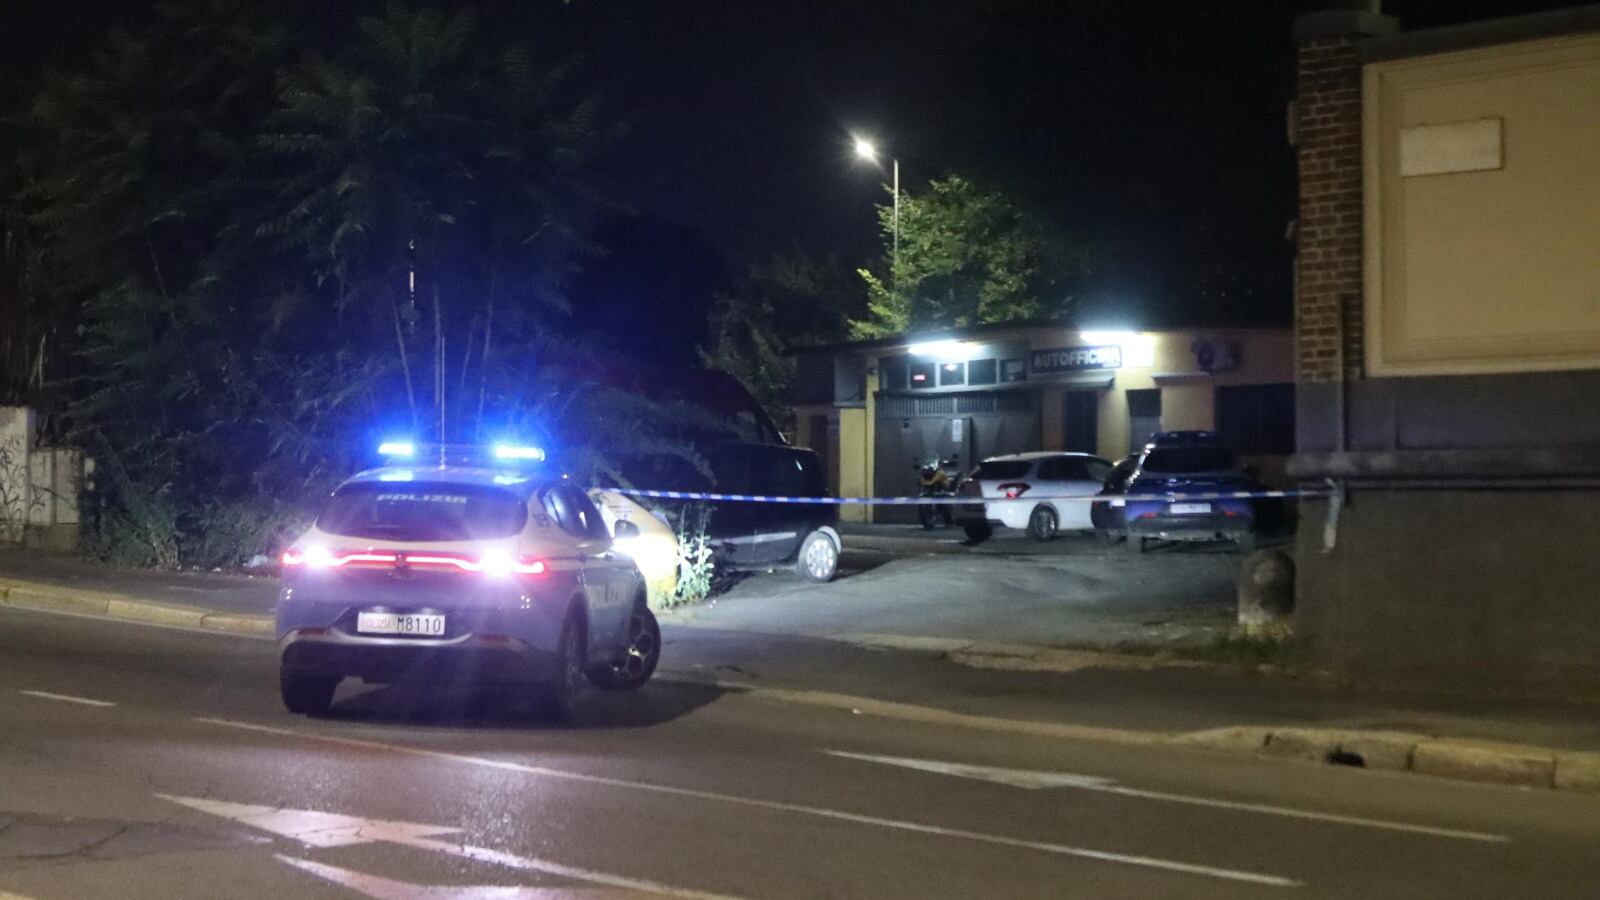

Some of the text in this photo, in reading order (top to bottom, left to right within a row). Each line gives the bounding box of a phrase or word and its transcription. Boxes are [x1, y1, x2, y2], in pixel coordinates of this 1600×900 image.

[1033, 347, 1120, 367] AUTOFFICA
[376, 494, 467, 504] POLIZIA
[396, 615, 442, 633] M8110
